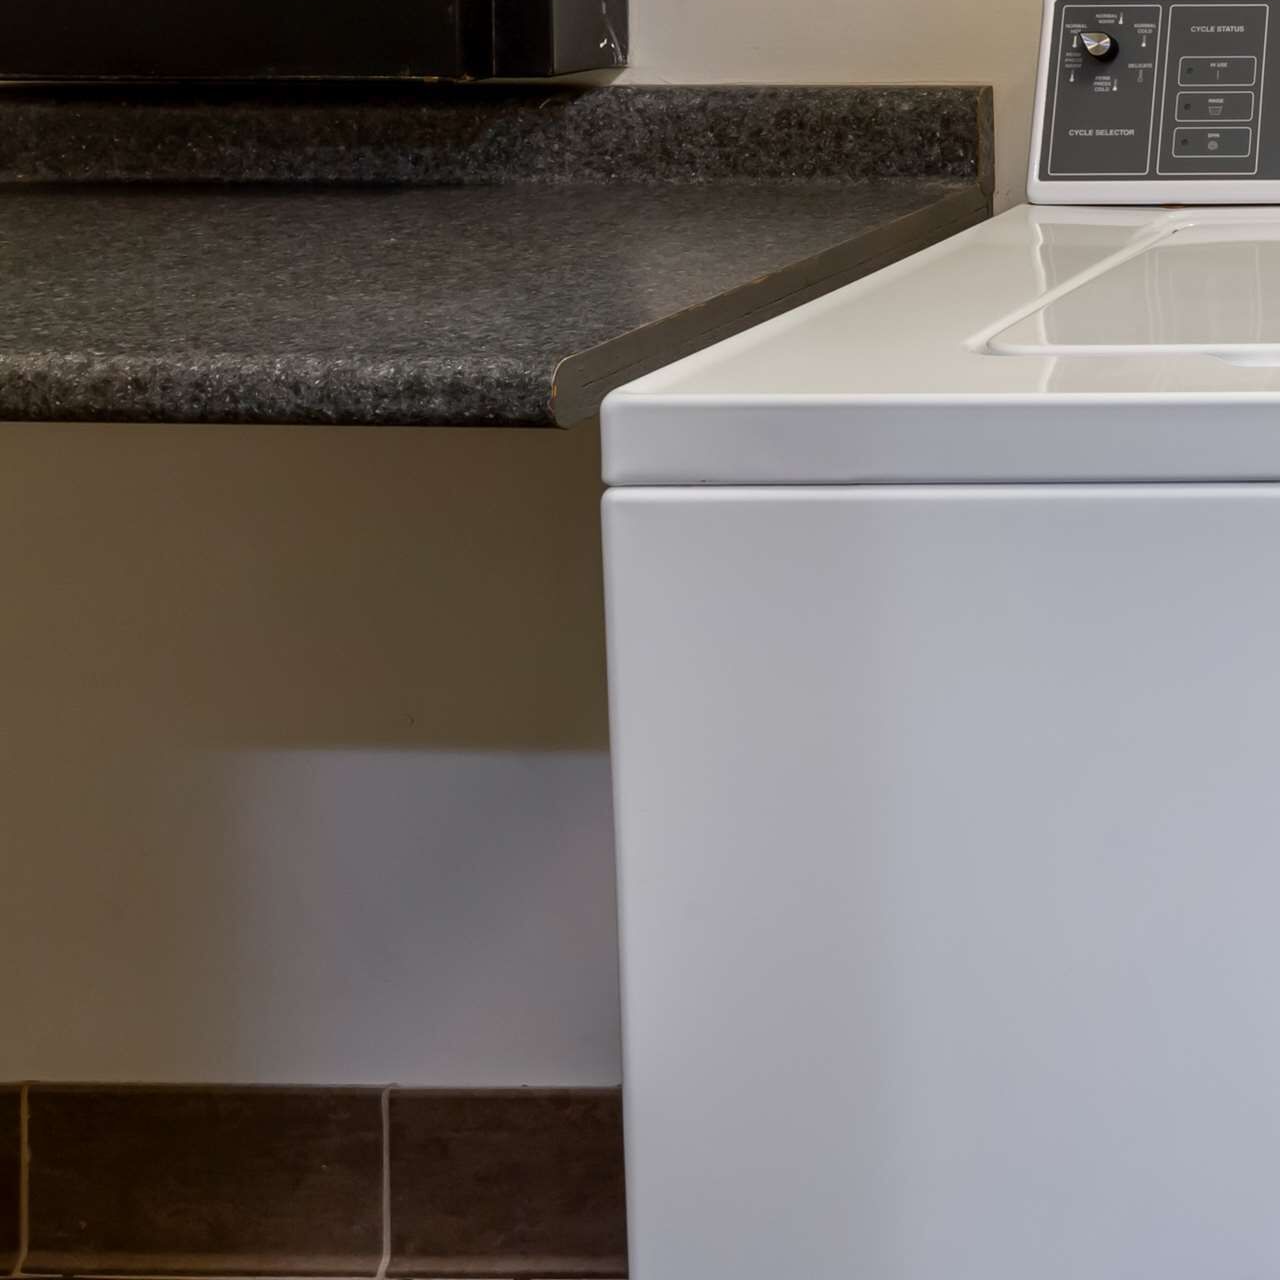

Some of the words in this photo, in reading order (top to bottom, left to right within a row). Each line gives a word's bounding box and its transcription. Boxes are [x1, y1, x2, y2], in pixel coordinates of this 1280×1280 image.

[1190, 25, 1215, 33] CYCLE
[1216, 25, 1245, 33] STATUS
[1068, 128, 1094, 136] CYCLE
[1095, 128, 1135, 136] SELECTOR
